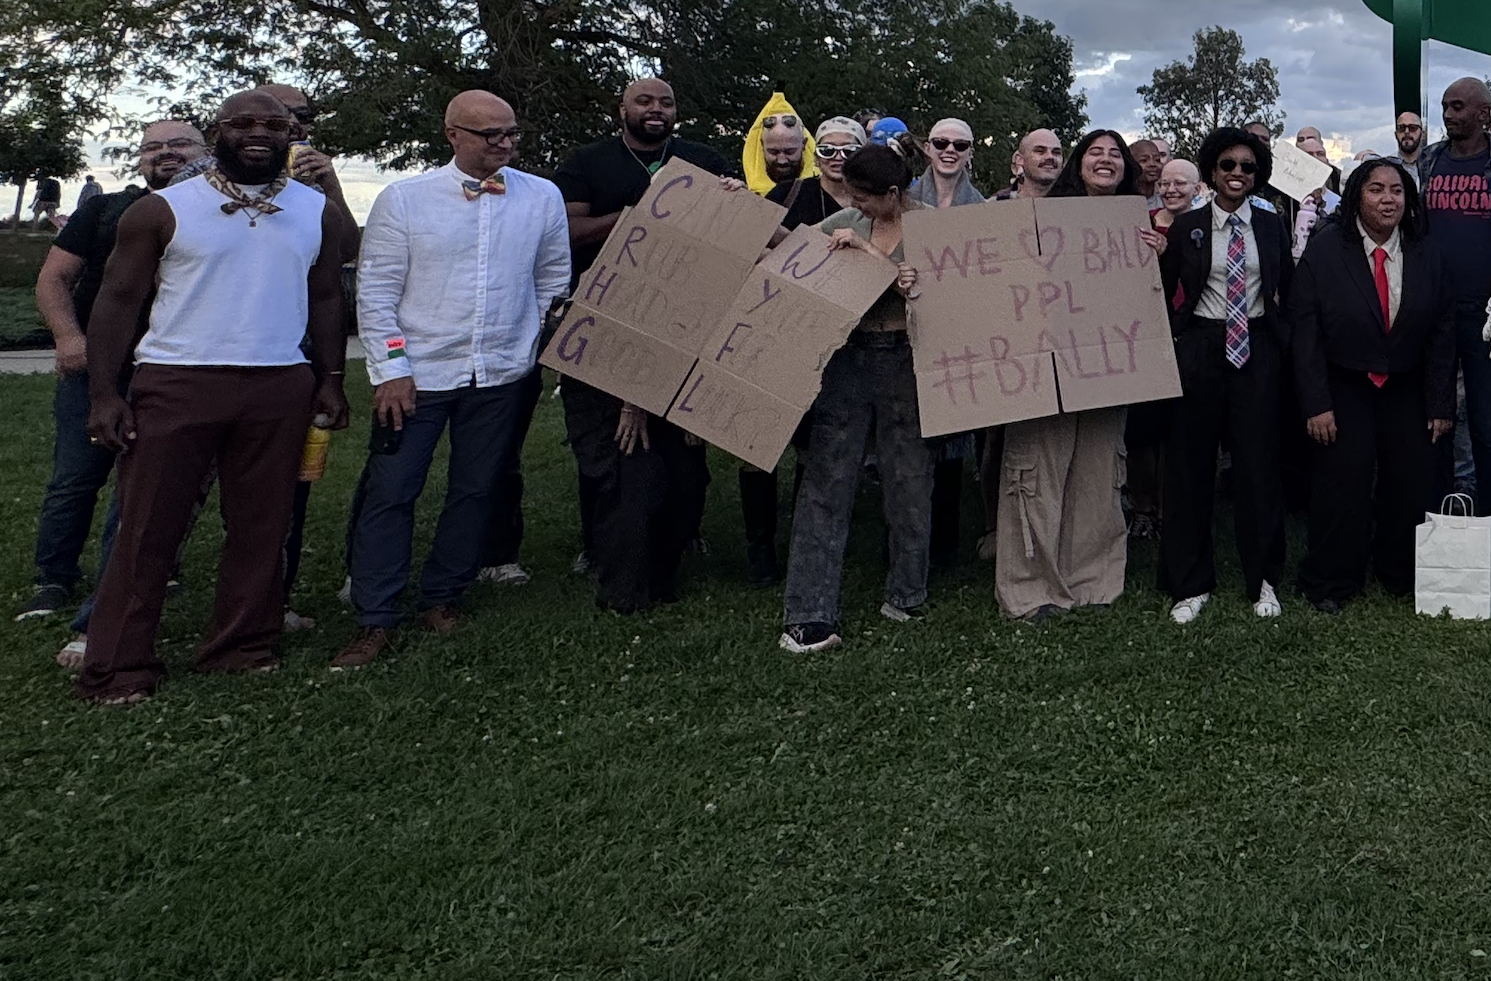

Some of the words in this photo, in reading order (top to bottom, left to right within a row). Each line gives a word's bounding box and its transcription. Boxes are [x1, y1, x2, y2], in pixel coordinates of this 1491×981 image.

[924, 236, 1003, 282] WE
[1082, 225, 1154, 274] BALD
[1008, 280, 1086, 322] PPL
[932, 320, 1142, 407] #BALLY
